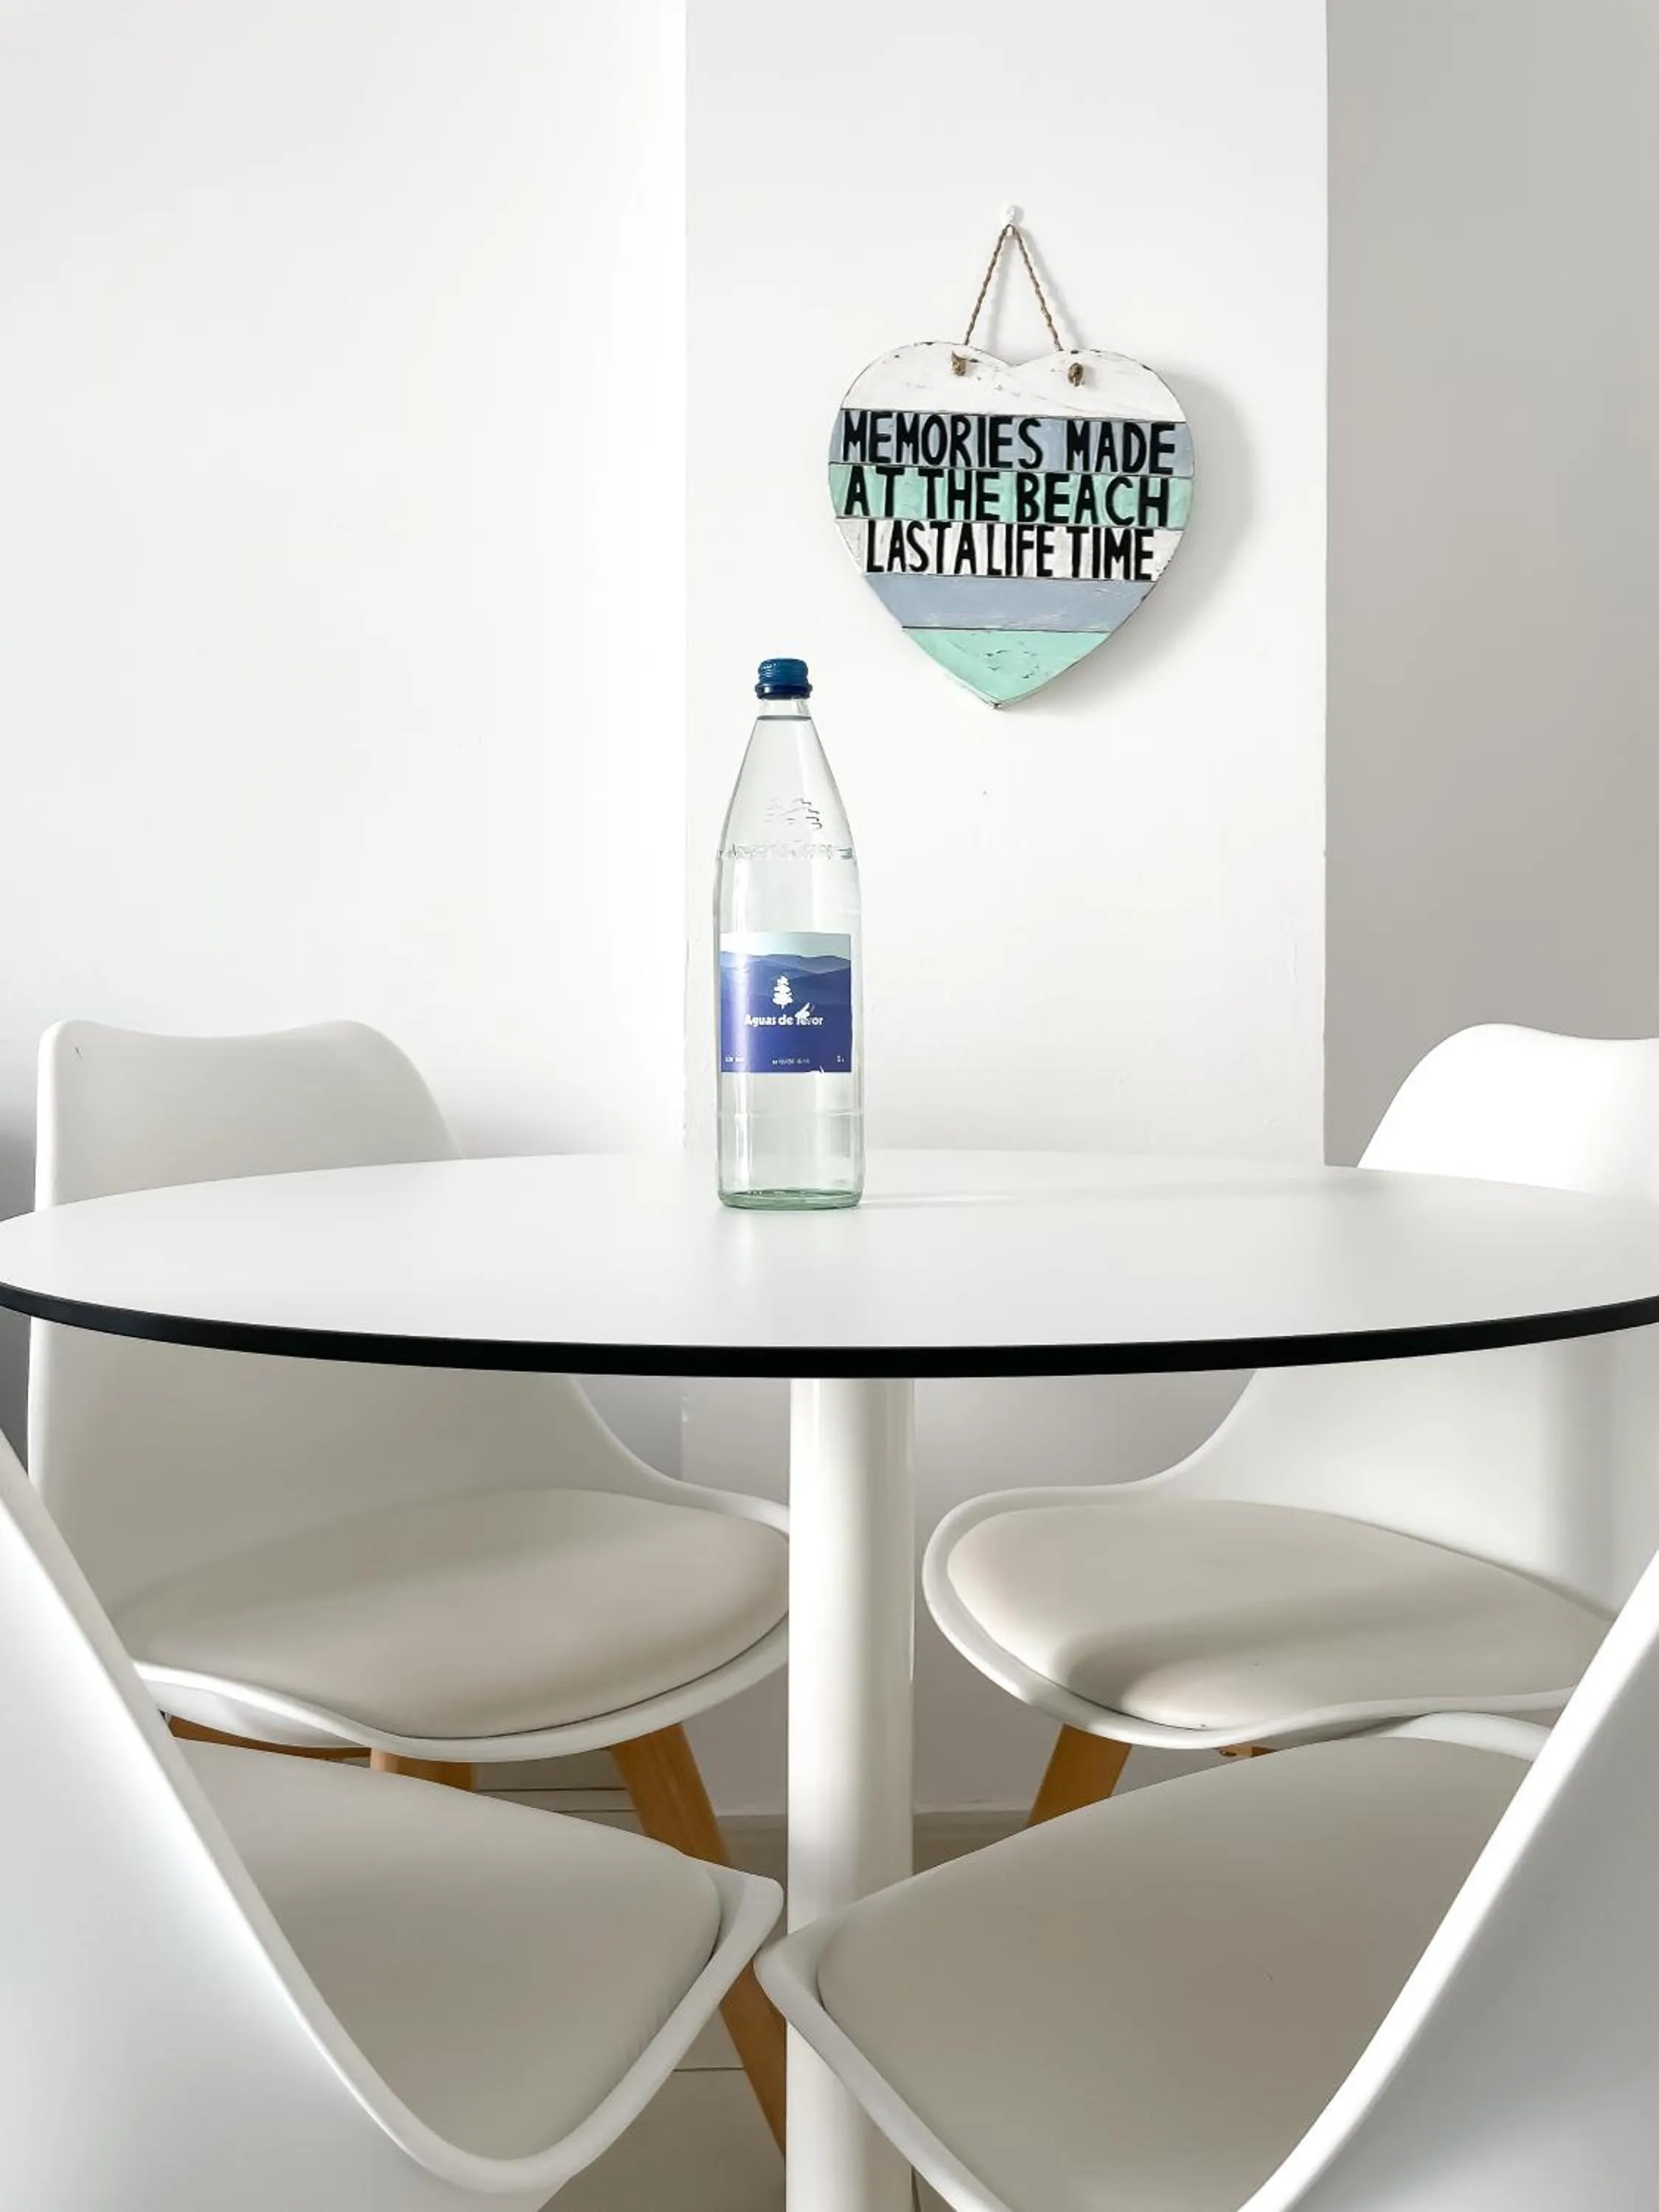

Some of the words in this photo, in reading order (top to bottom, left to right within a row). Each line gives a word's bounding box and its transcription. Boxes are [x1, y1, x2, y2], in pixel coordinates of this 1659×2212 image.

[843, 411, 1043, 469] MEMORIES
[1066, 420, 1175, 474] MADE
[844, 465, 904, 517] AT
[918, 467, 1000, 521] THE
[1017, 472, 1169, 527] BEACH
[866, 520, 952, 573] LAST
[779, 1015, 793, 1025] de
